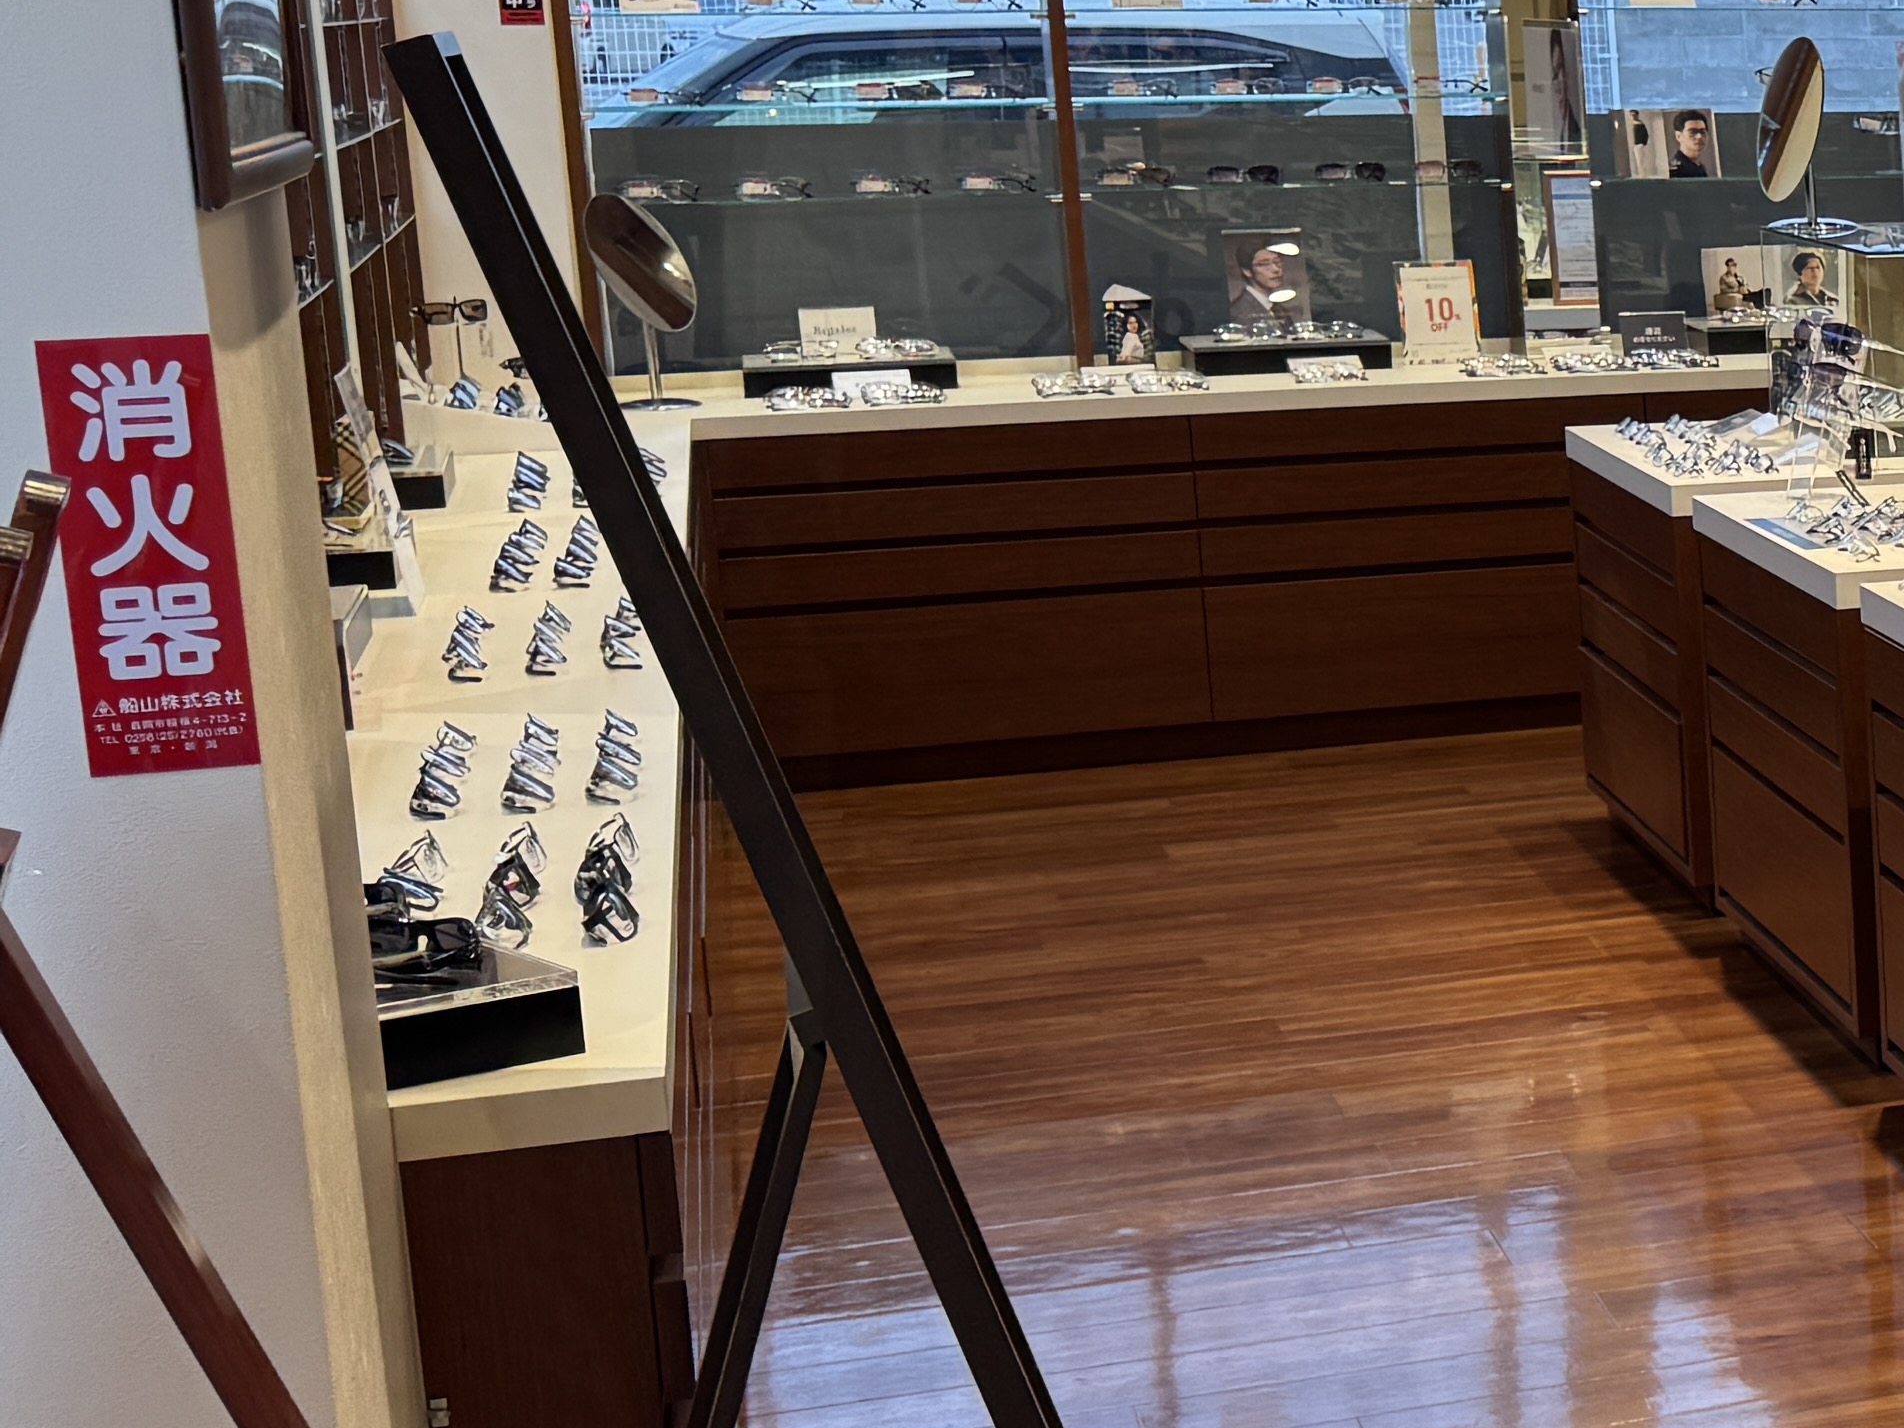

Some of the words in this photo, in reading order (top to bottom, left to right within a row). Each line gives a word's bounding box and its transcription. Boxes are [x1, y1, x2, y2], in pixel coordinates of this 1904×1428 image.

[70, 359, 222, 681] 消火器
[118, 689, 244, 714] 船山株式会社
